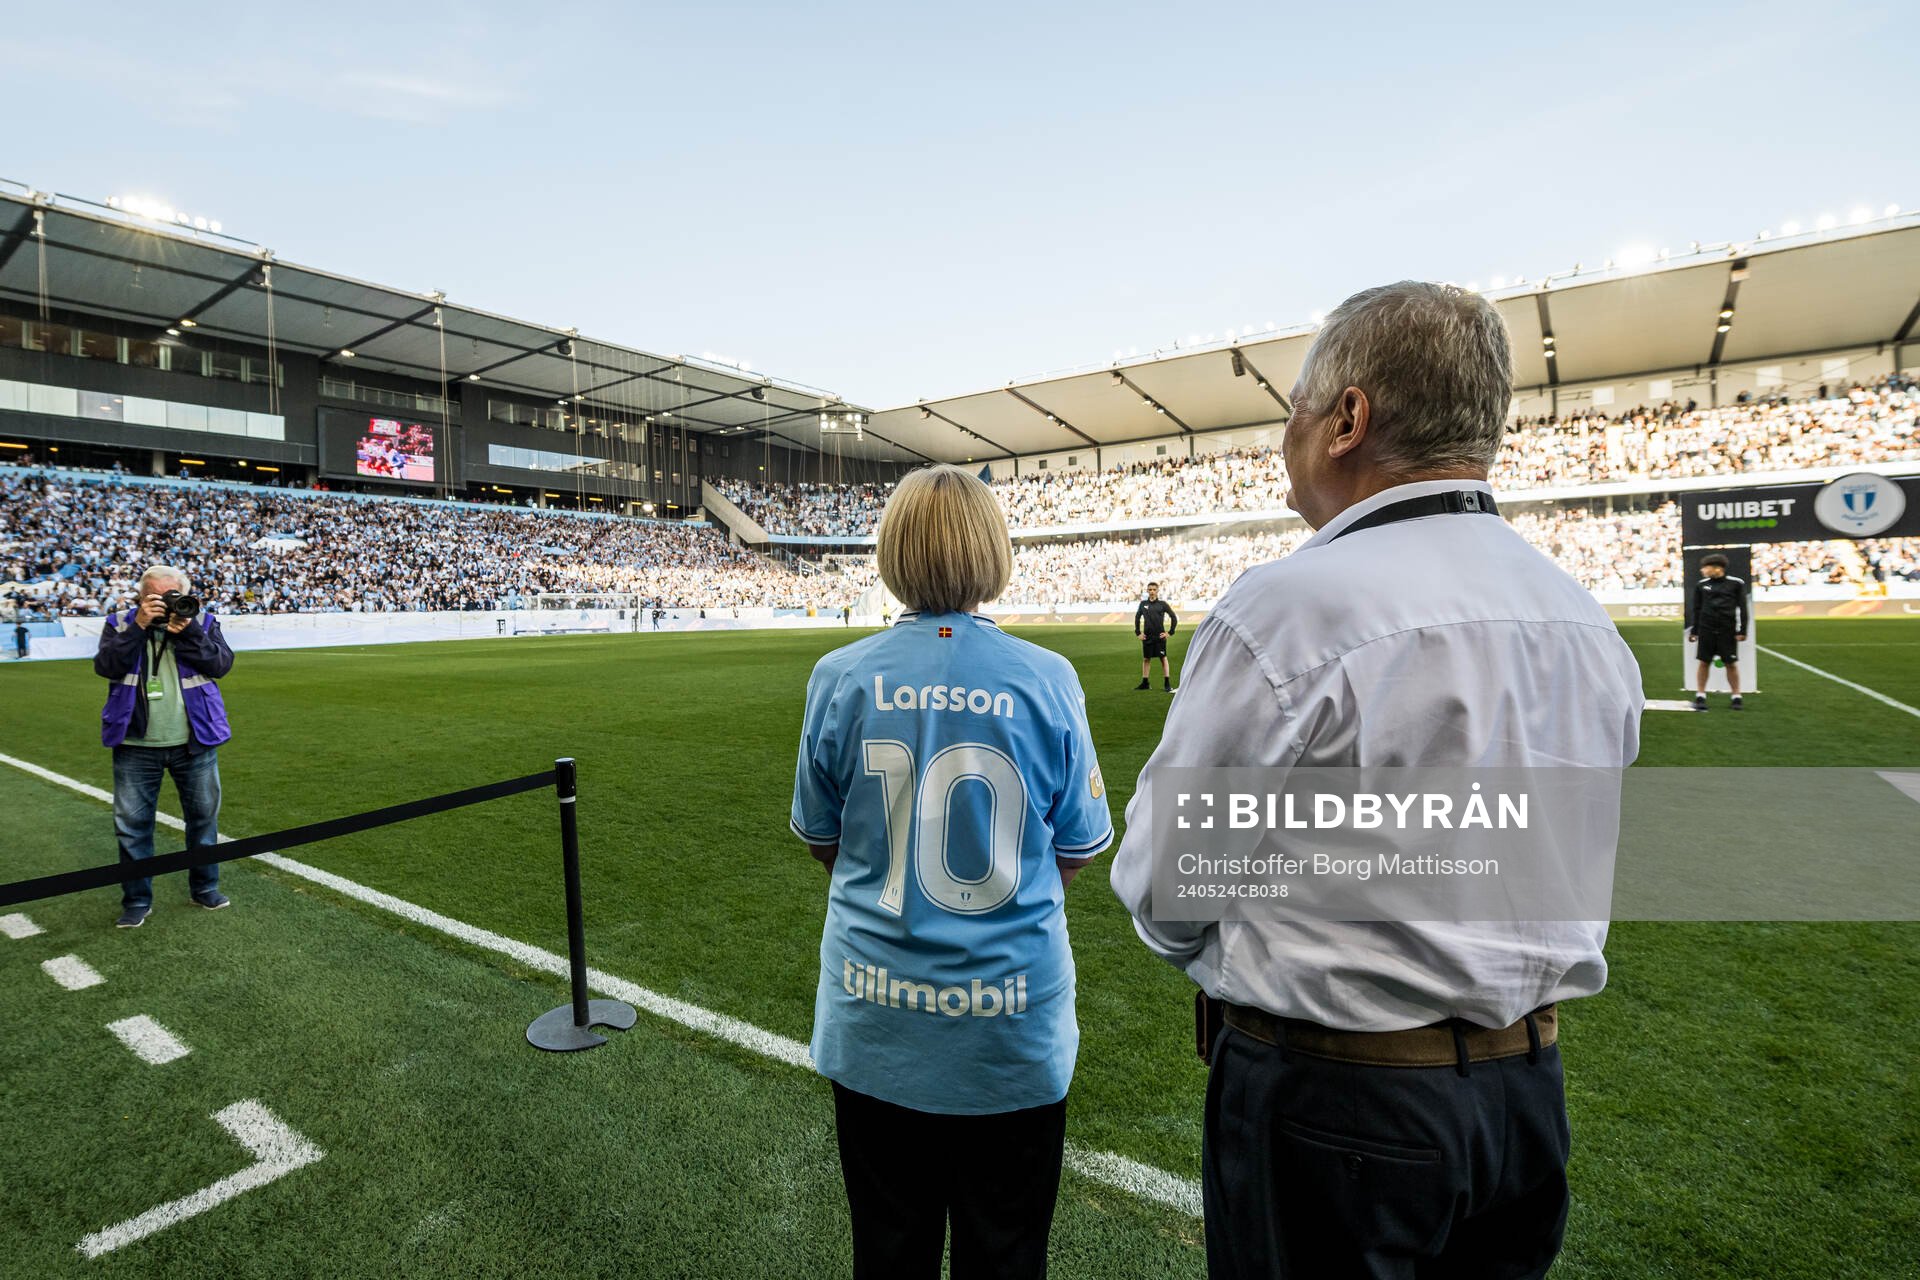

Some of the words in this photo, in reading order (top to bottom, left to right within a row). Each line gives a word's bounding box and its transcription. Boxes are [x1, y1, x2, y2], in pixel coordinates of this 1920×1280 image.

[1697, 498, 1796, 520] UNIBET
[875, 675, 1014, 718] Larsson
[862, 739, 1028, 916] 10
[843, 959, 1028, 1017] tillmobil
